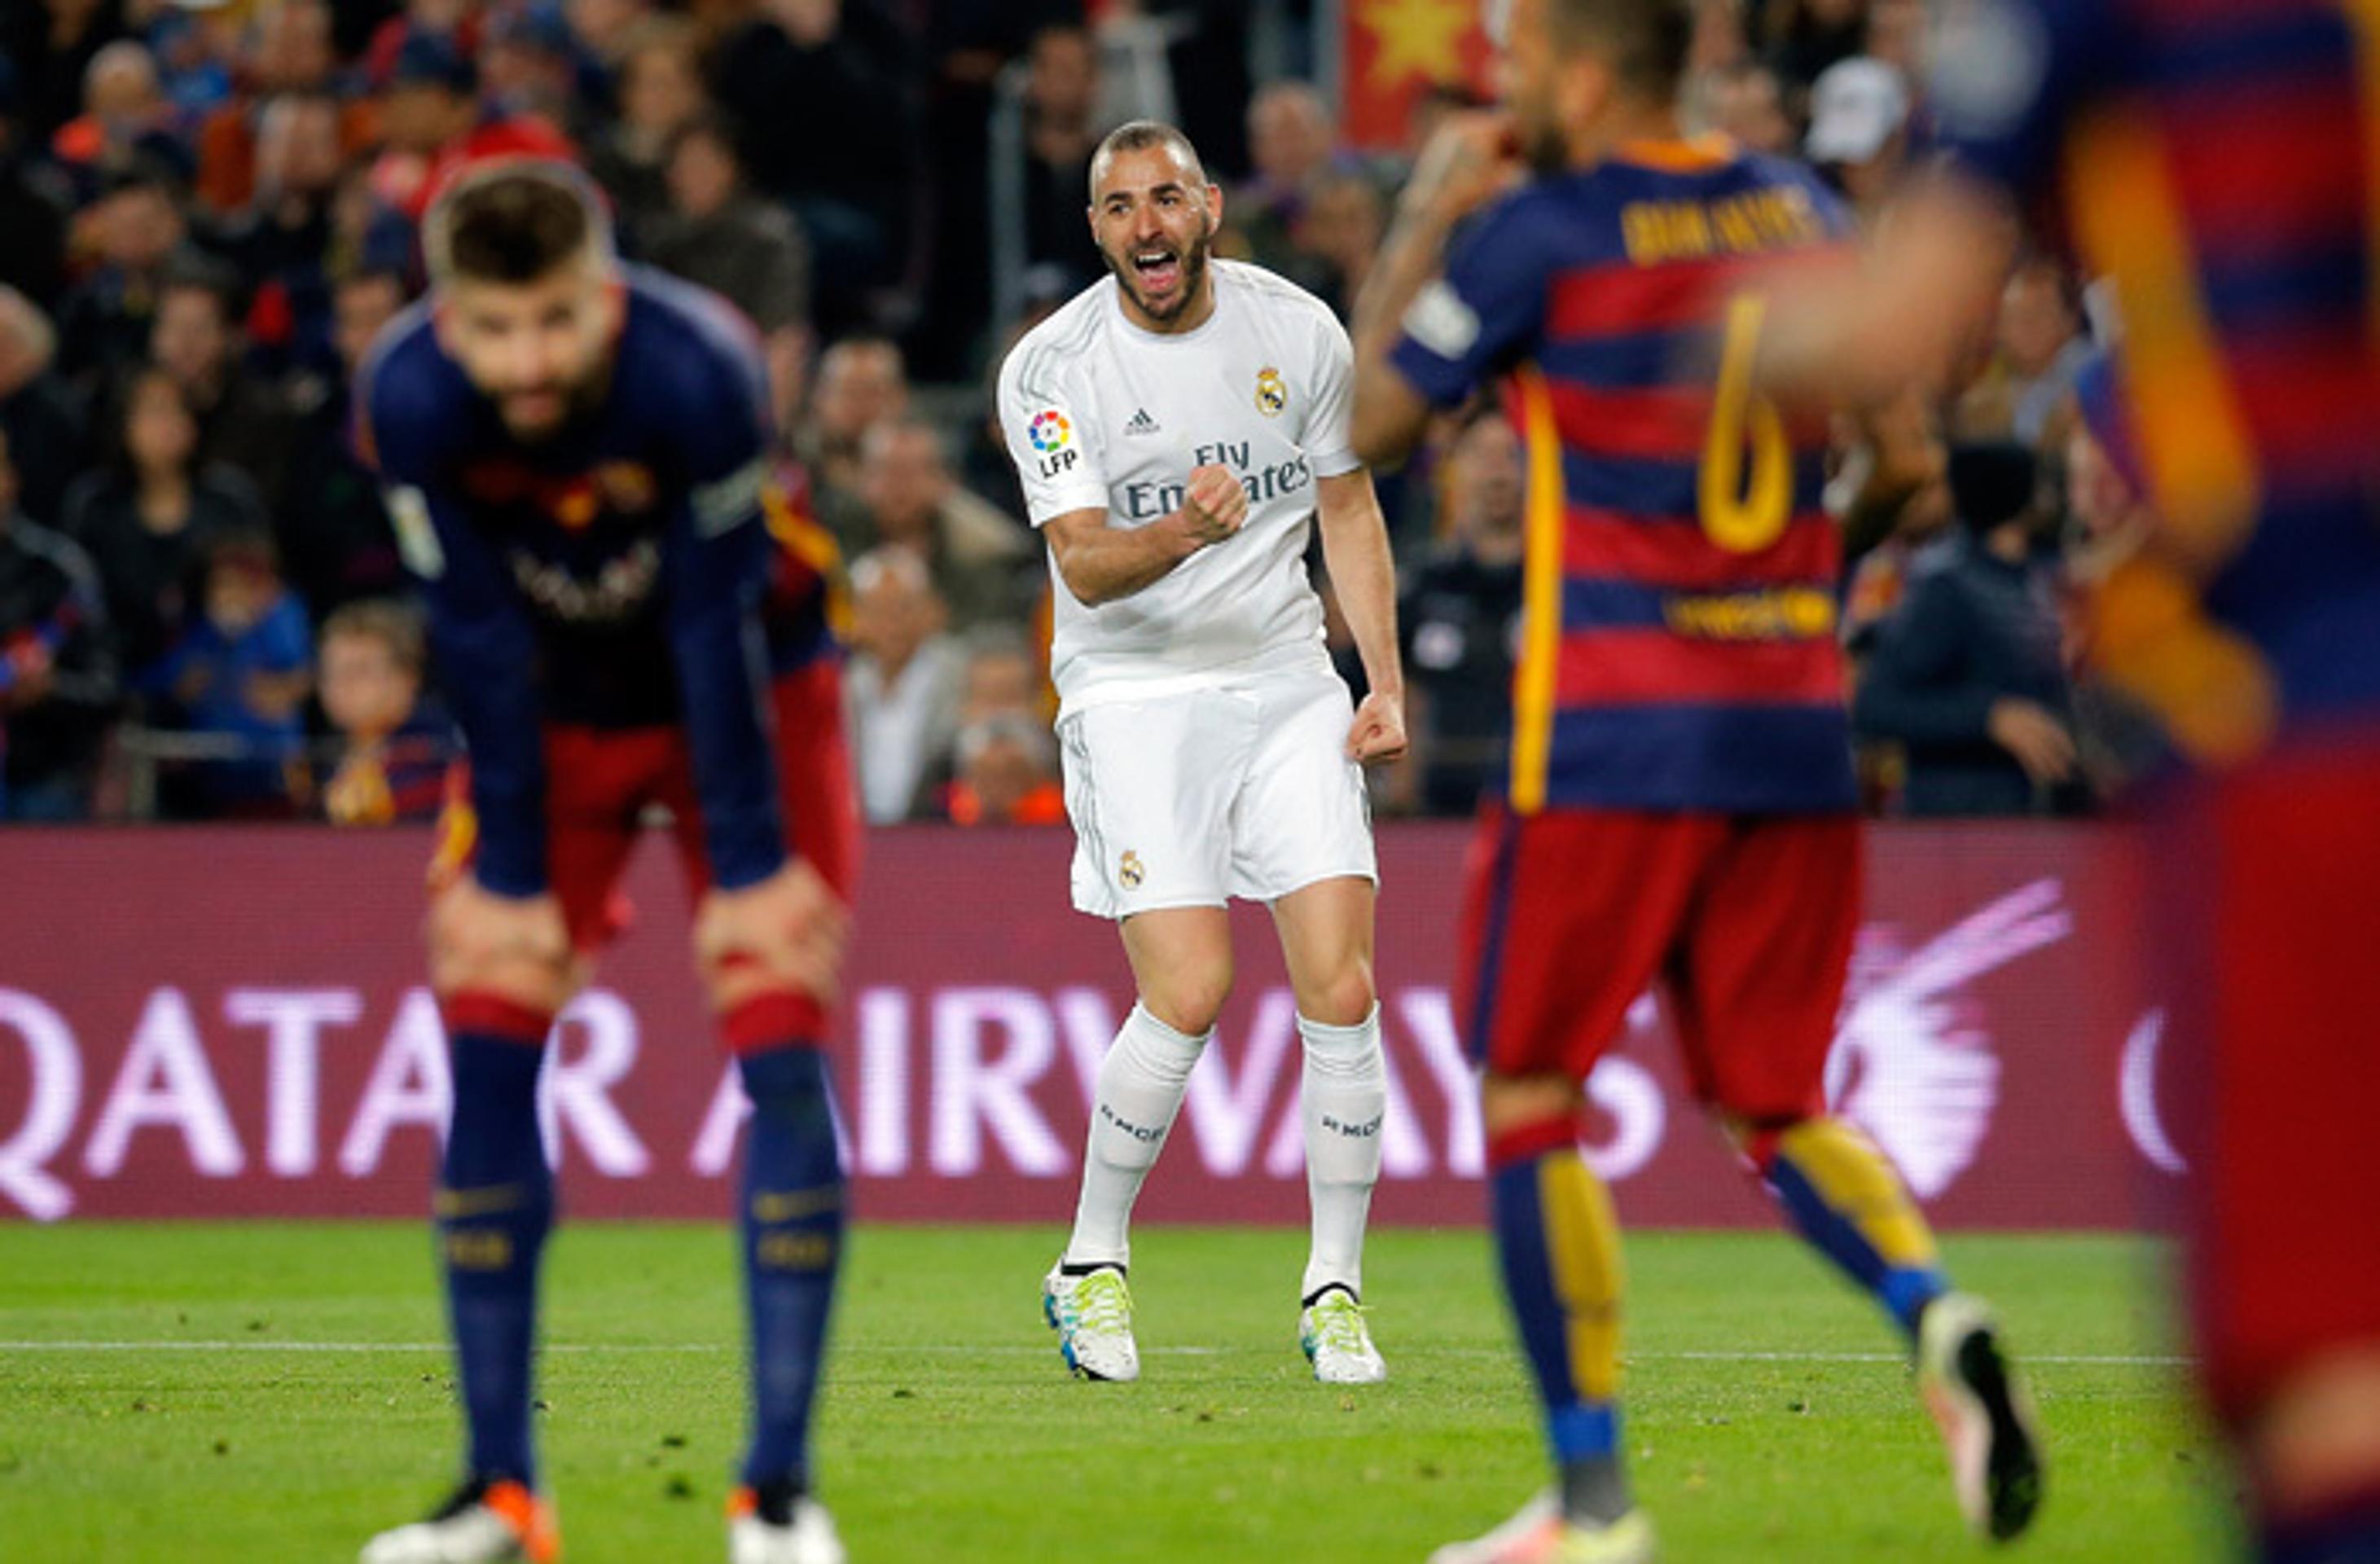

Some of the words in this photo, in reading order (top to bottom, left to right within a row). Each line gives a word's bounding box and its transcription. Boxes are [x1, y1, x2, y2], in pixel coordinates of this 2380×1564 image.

[1039, 448, 1078, 480] LFP
[1195, 440, 1249, 470] Fly
[1126, 455, 1310, 518] Emates
[0, 986, 648, 1220] QATAR
